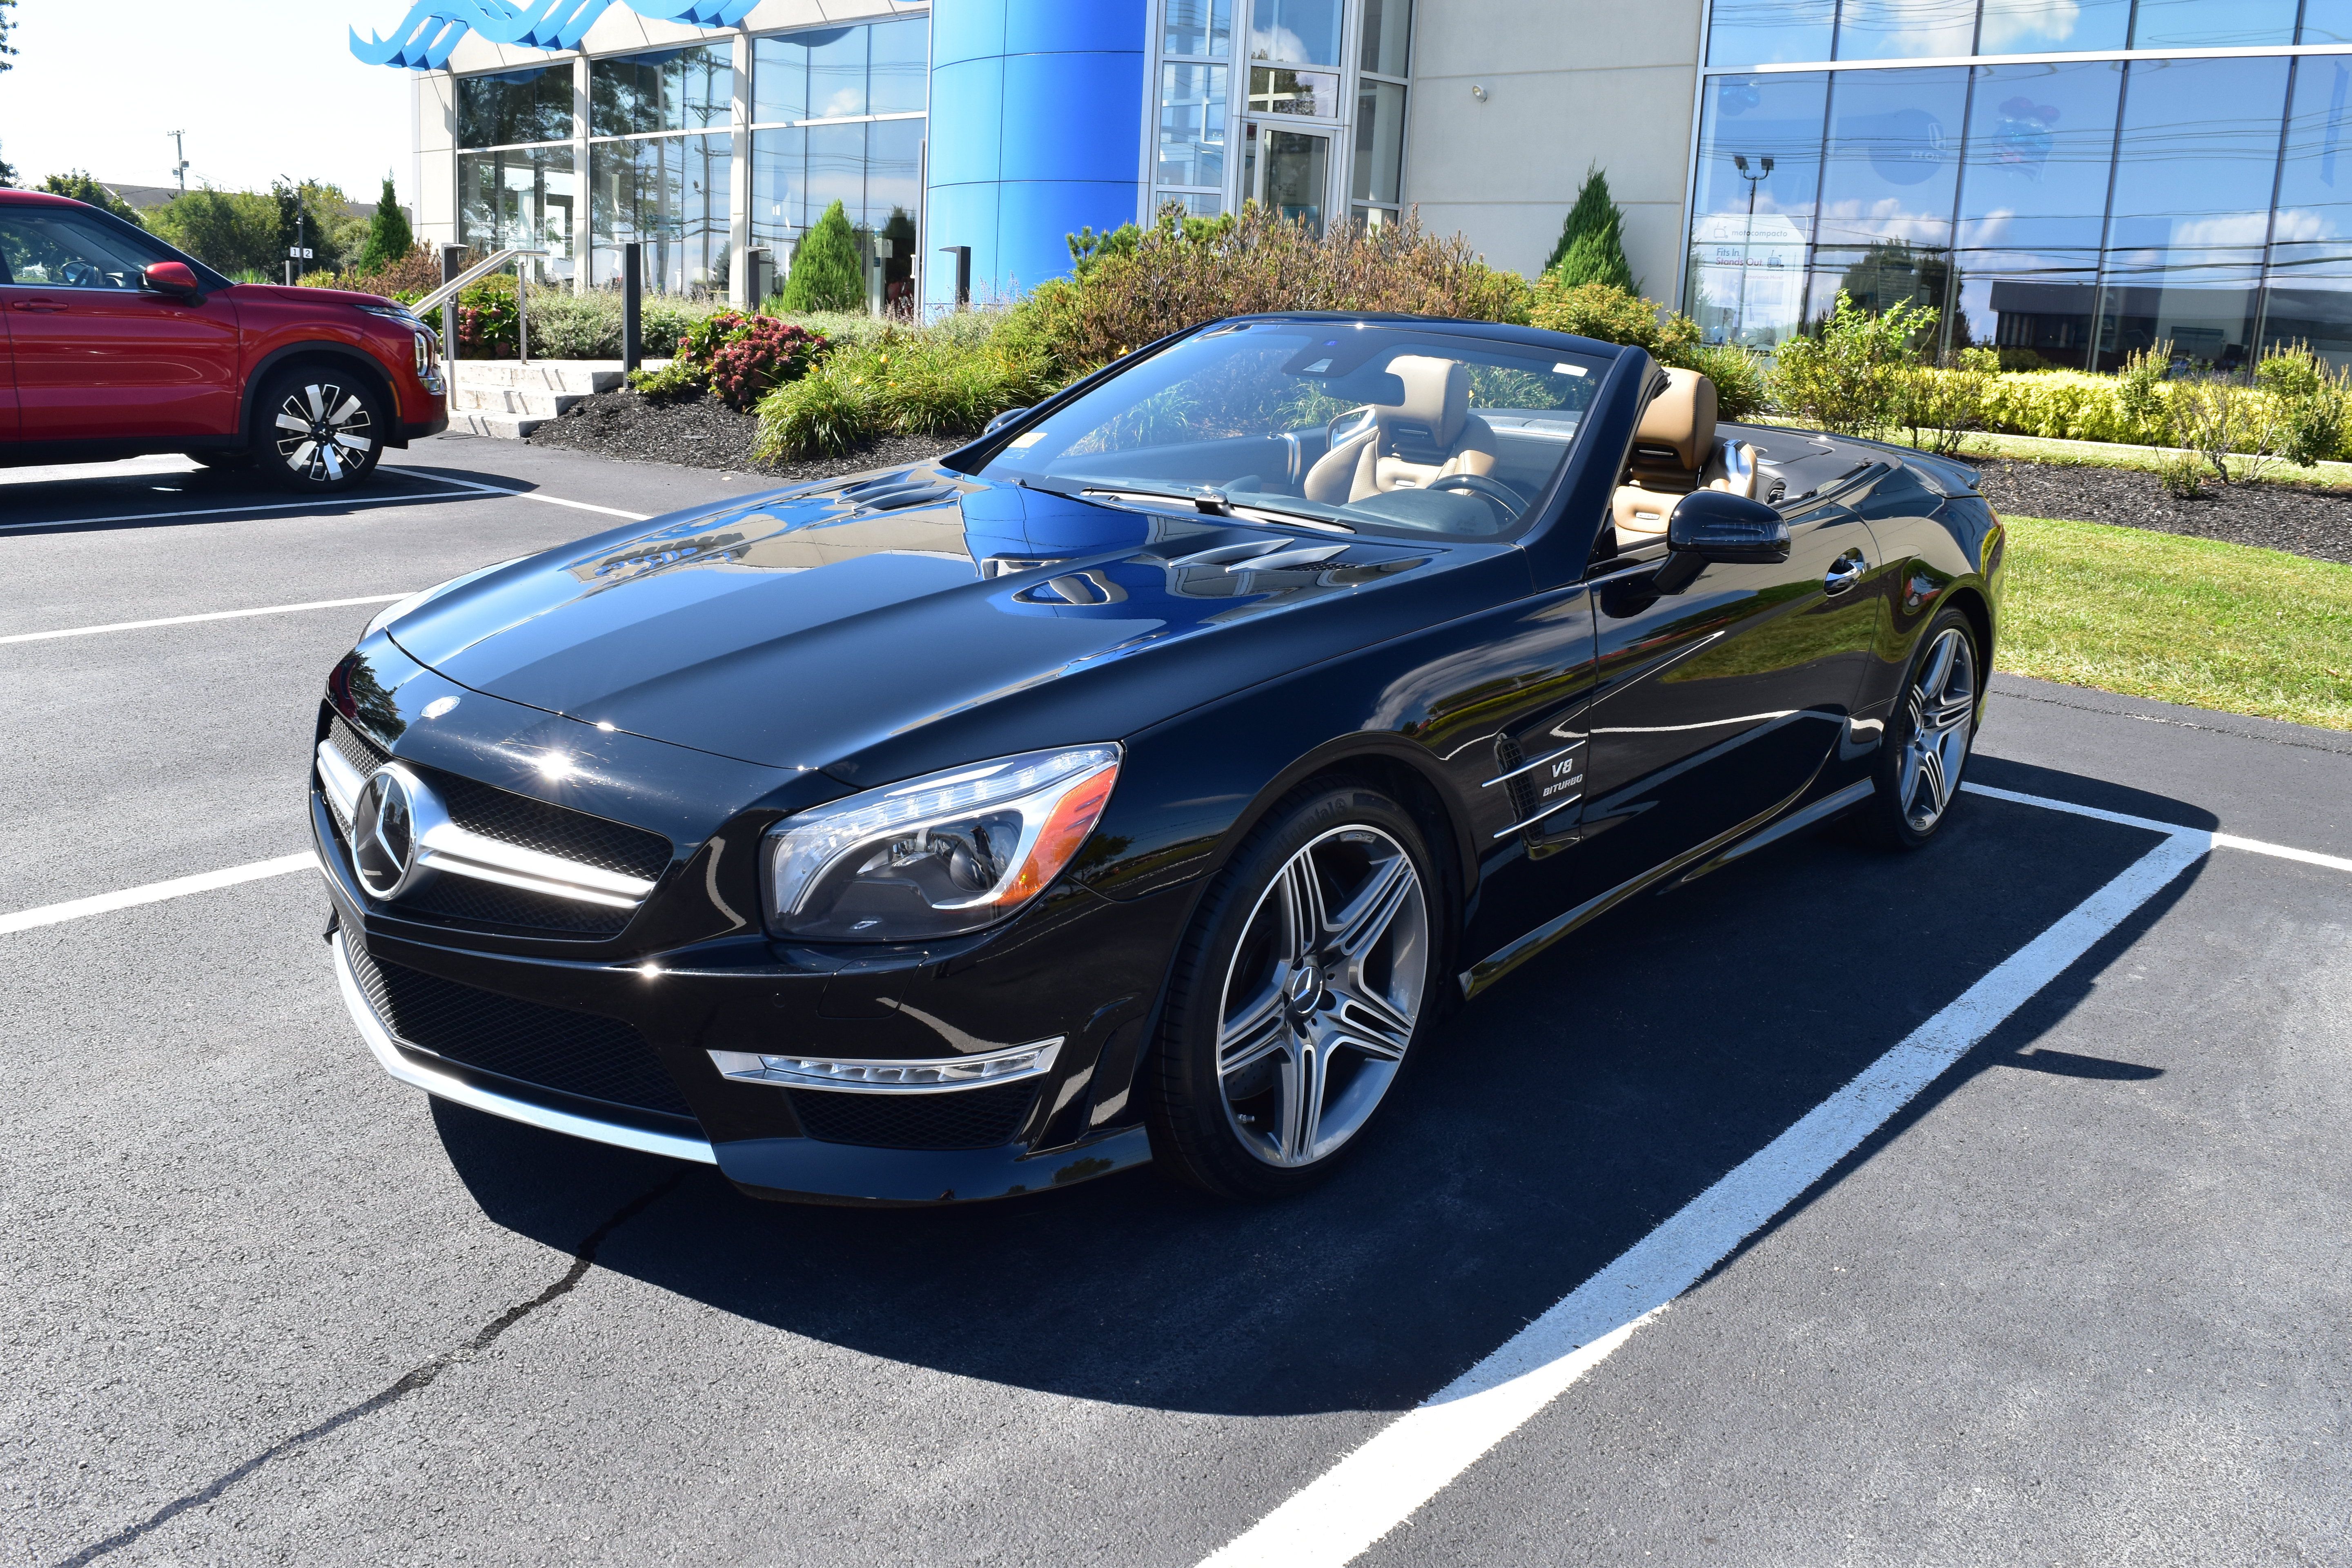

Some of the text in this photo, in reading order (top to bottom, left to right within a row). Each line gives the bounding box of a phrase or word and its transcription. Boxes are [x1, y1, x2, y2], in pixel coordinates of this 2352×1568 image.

[1716, 248, 1730, 256] Fits
[1716, 257, 1764, 266] Stands Out.
[1552, 758, 1572, 777] V8
[1543, 774, 1583, 797] BITURBO
